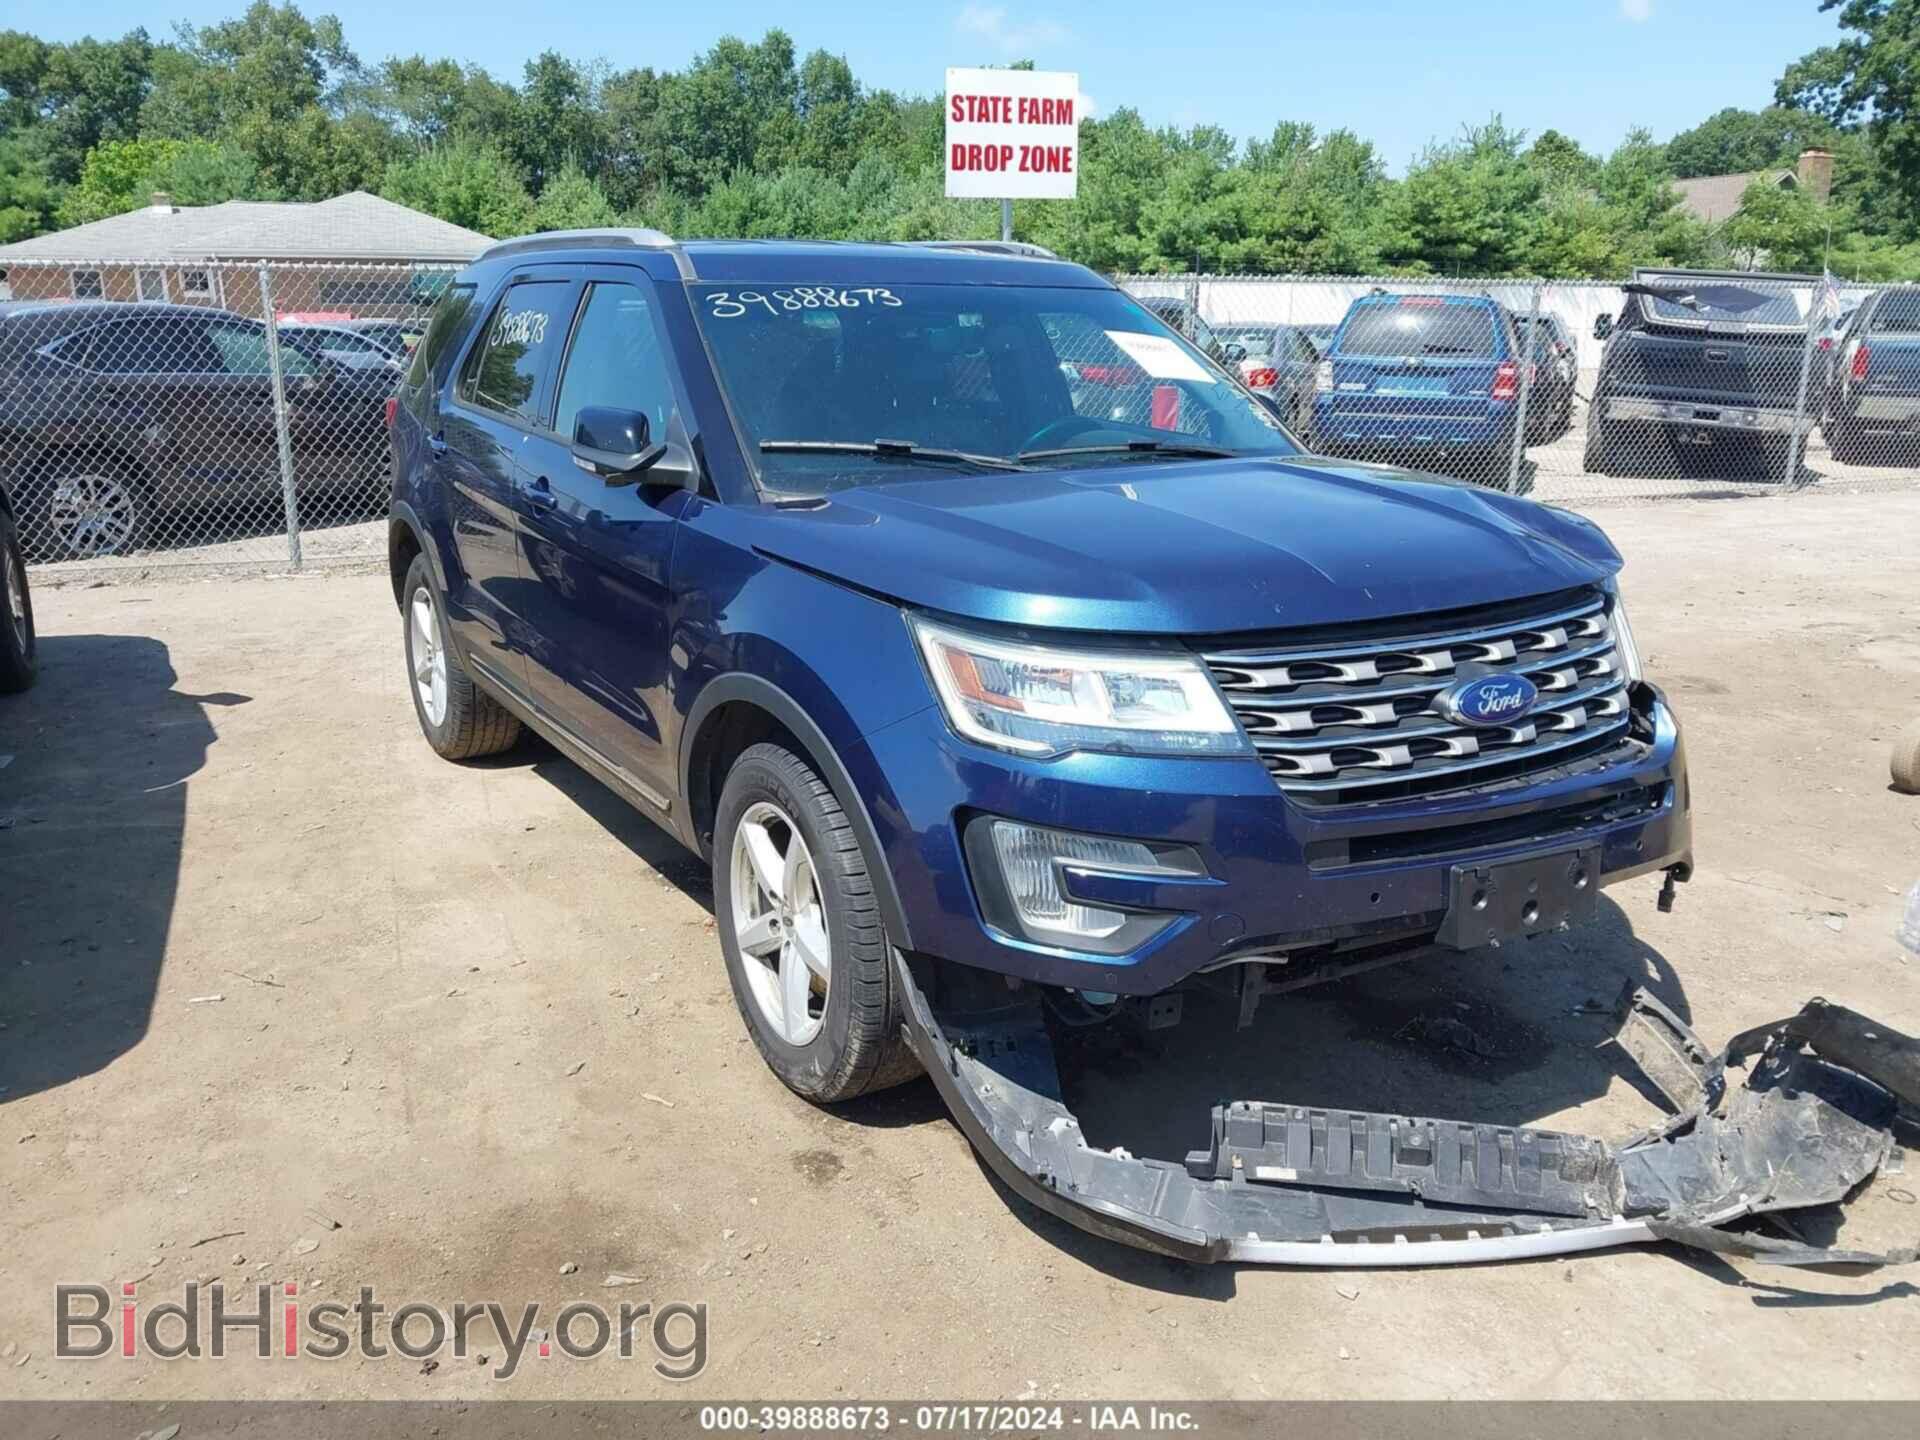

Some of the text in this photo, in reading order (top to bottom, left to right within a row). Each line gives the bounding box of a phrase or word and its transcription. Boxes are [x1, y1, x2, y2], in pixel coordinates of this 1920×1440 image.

[951, 95, 1073, 125] STATE FARM
[951, 144, 1073, 173] DROP ZONE
[706, 287, 903, 317] 39888673
[1478, 683, 1522, 715] Ford
